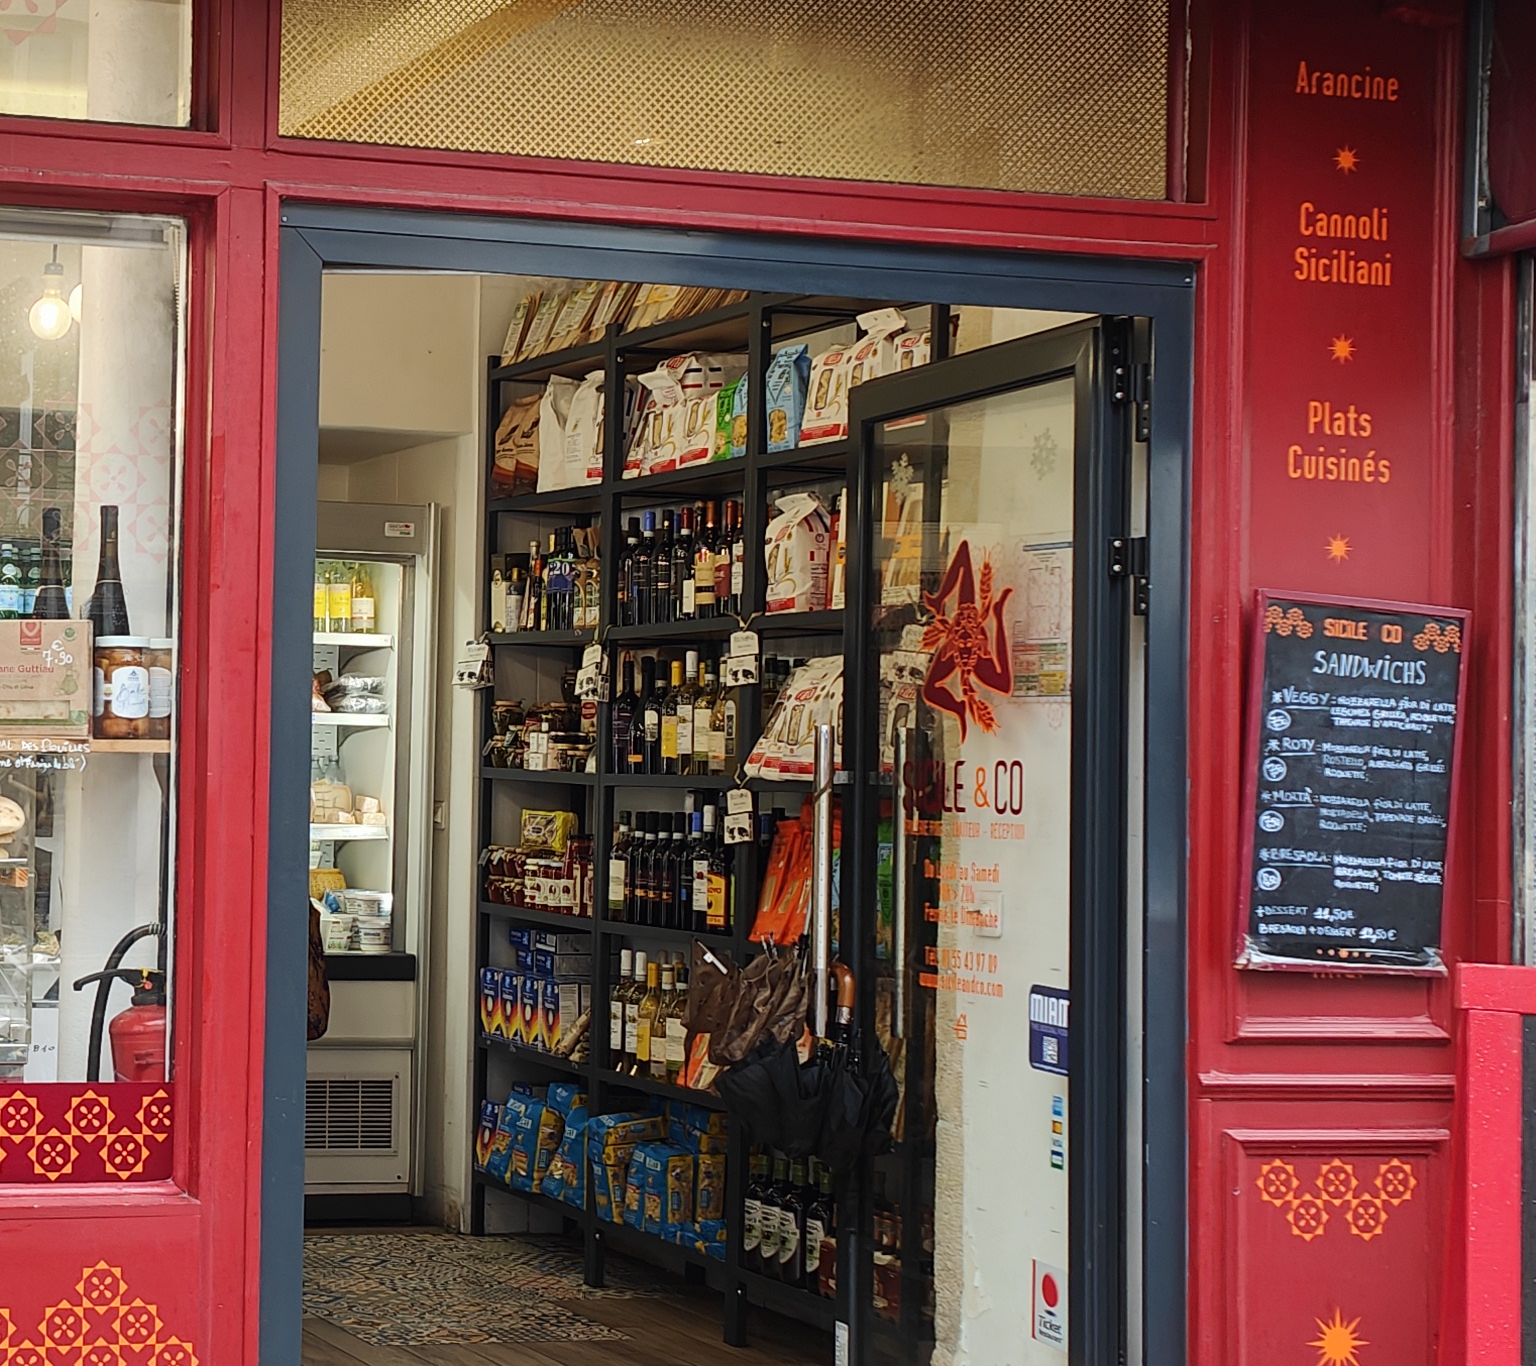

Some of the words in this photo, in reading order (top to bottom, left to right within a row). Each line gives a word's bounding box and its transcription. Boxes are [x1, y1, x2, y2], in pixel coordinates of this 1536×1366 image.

[1294, 60, 1400, 102] Arancine
[1299, 201, 1389, 242] Cannoli
[1293, 246, 1393, 287] Siciliani
[1307, 400, 1373, 438] Plats
[1287, 444, 1392, 485] Cuisinés
[973, 766, 991, 808] &
[994, 759, 1023, 815] CO
